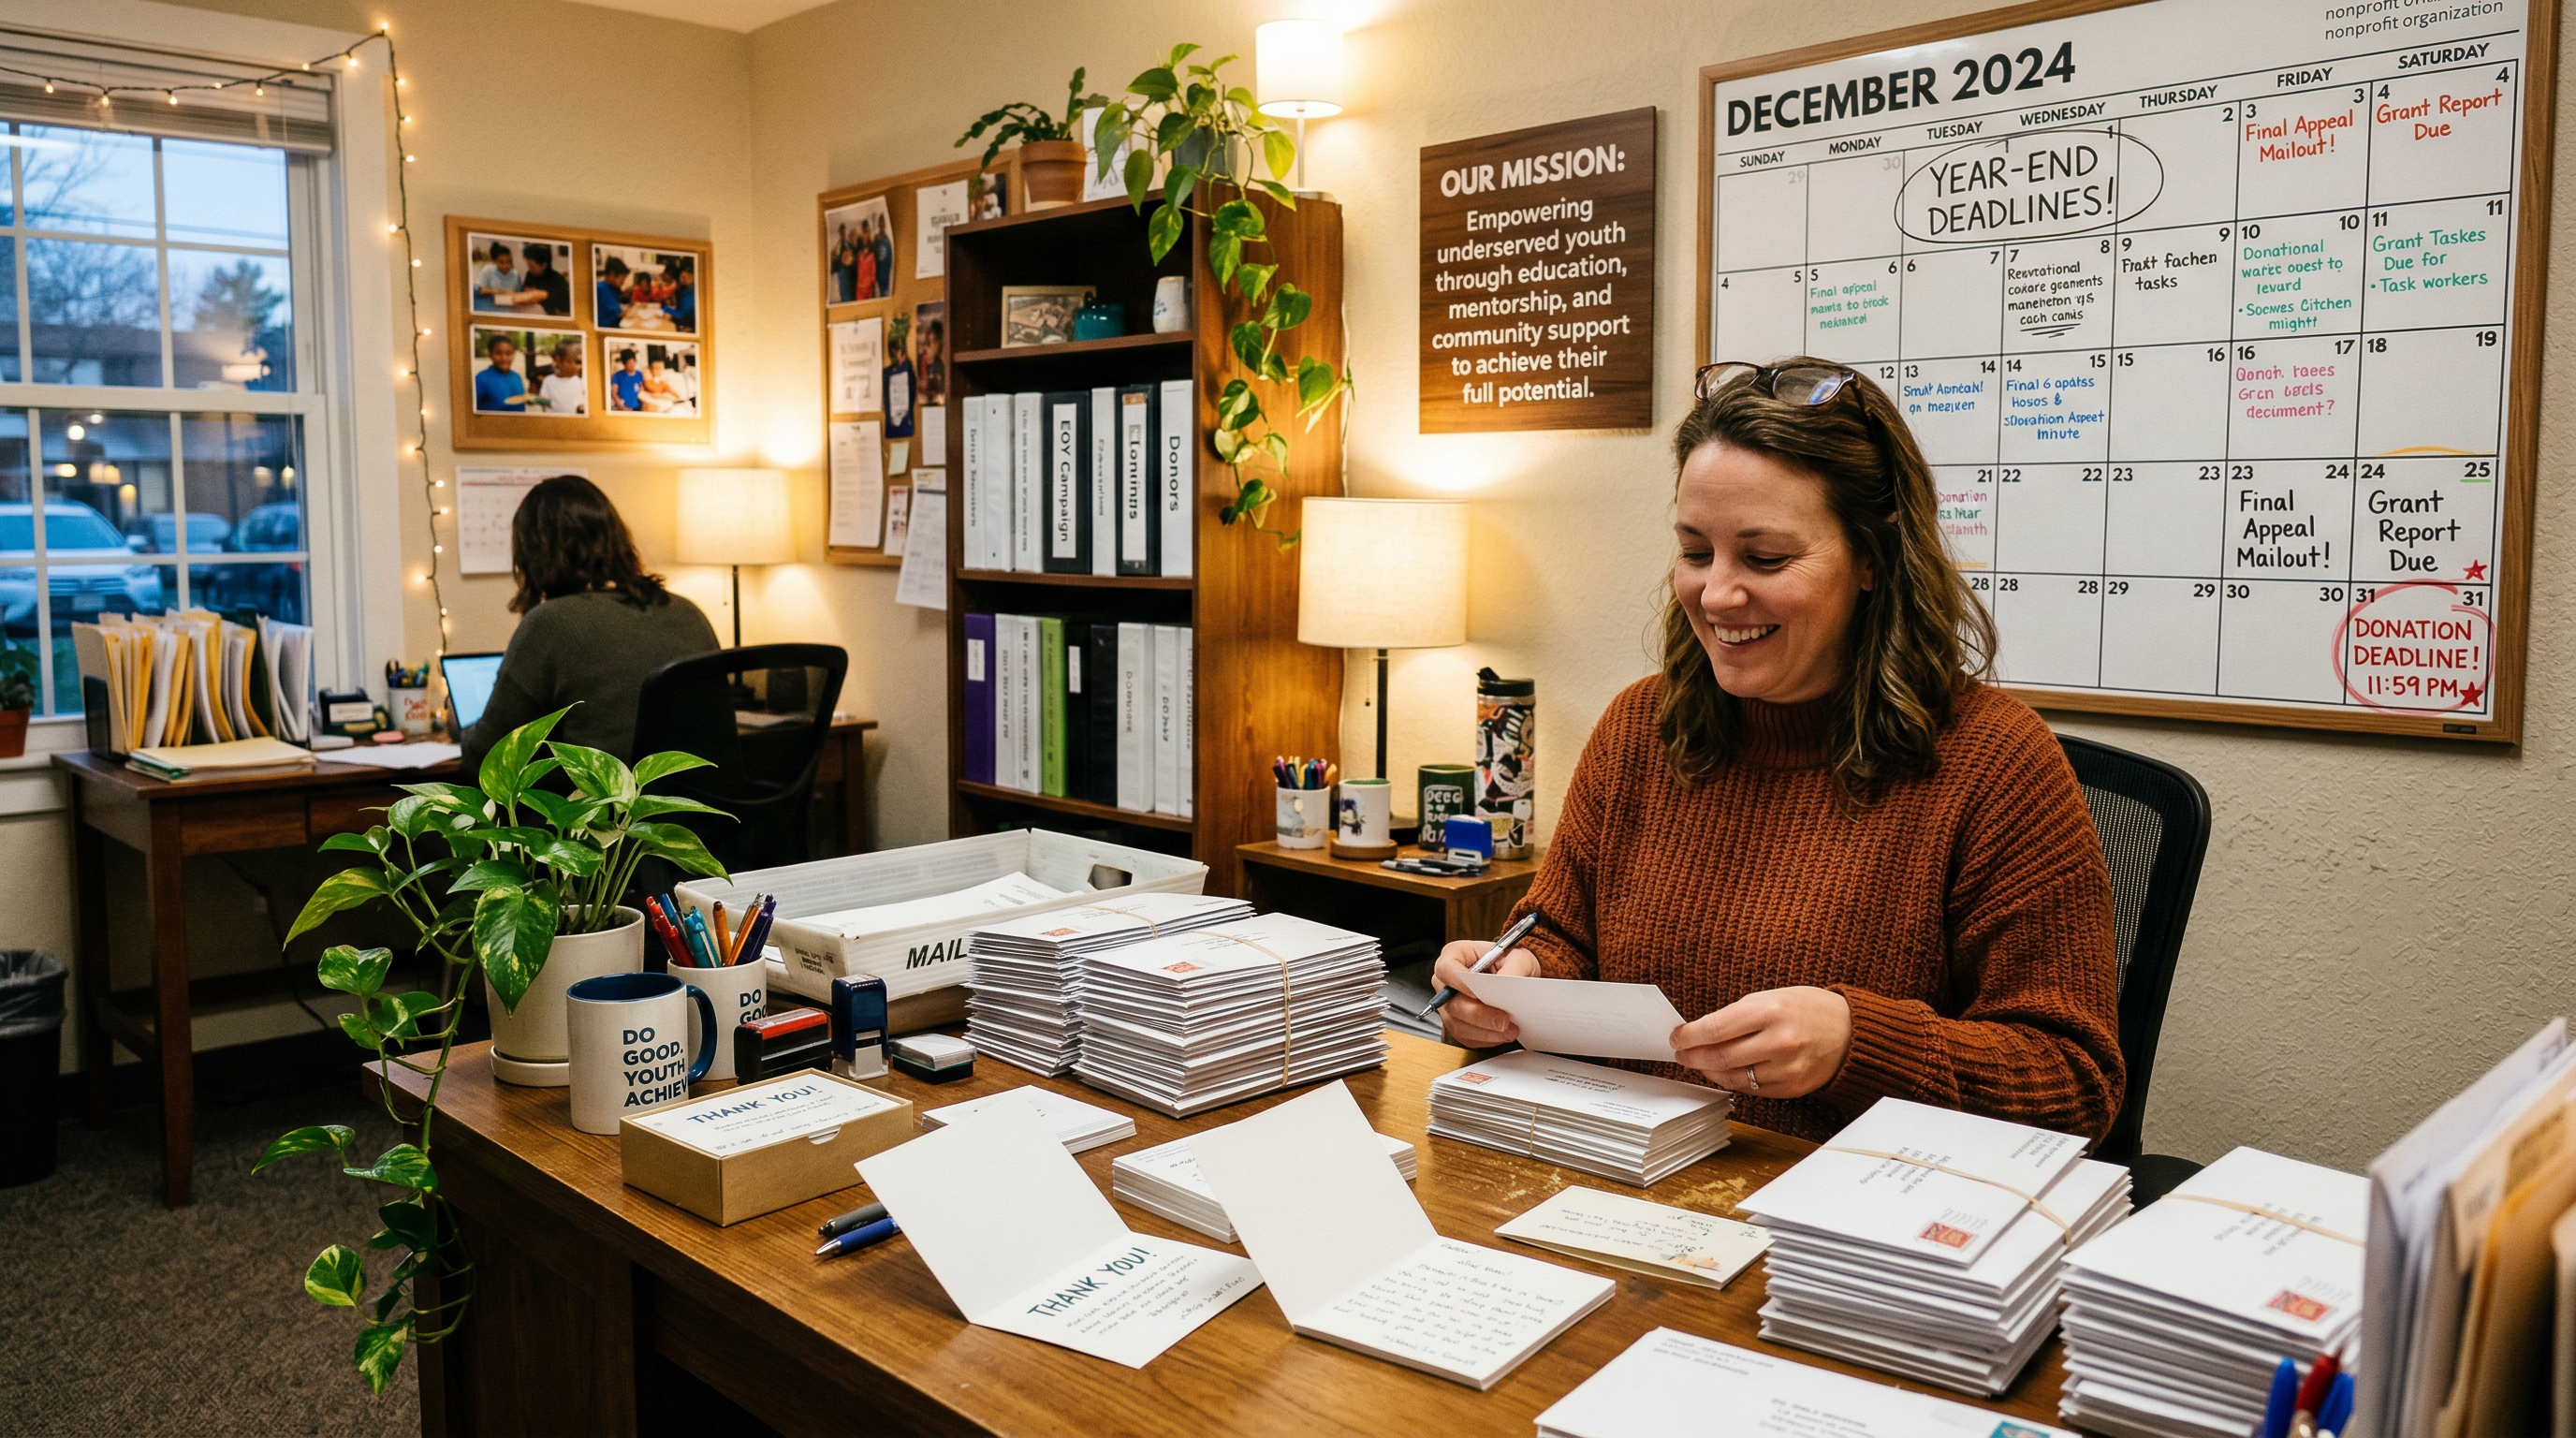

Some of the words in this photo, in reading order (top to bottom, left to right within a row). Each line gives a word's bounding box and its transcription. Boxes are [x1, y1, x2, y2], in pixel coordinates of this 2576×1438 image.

[2325, 0, 2399, 20] nonprofit
[2325, 16, 2398, 39] nonprofit
[2403, 1, 2503, 28] organization
[2397, 42, 2490, 69] SATURDAY
[2276, 67, 2334, 87] FRIDAY
[2496, 66, 2510, 83] 4
[1727, 66, 1939, 137] DECEMBER
[1952, 41, 2075, 101] 2024
[2139, 84, 2218, 109] THURSDAY
[2353, 88, 2364, 104] 3
[2378, 84, 2390, 100] 4
[2019, 100, 2105, 125] WEDNESDAY
[2247, 104, 2257, 119] 3
[2376, 98, 2431, 125] Grant
[2438, 87, 2503, 120] Report
[2222, 108, 2233, 122] 2
[1926, 121, 1983, 140] TUESDAY
[2107, 125, 2114, 139] 1
[2246, 119, 2288, 141] Final
[2293, 109, 2354, 139] Appeal
[2413, 121, 2452, 141] Due
[1829, 137, 1881, 154] MONDAY
[2259, 134, 2335, 163] Mailout!
[1739, 152, 1785, 168] SUNDAY
[1882, 155, 1901, 170] 30
[1441, 164, 1496, 198] OUR
[1500, 143, 1626, 189] MISSION:
[1788, 169, 1806, 184] 29
[1929, 145, 2099, 198] YEAR-END
[1927, 177, 2114, 235] DEADLINES!
[2486, 199, 2503, 215] 11
[1467, 197, 1593, 233] Empowering
[2339, 213, 2360, 230] 10
[2373, 212, 2388, 227] 11
[2219, 227, 2230, 242] 9
[2241, 224, 2261, 240] 10
[1437, 228, 1559, 264] underserved
[1564, 220, 1626, 256] youth
[2100, 240, 2110, 254] 8
[2122, 238, 2132, 252] 9
[2373, 231, 2423, 253] Grant
[2429, 228, 2486, 246] Taskes
[2010, 249, 2019, 263] 7
[2244, 239, 2324, 260] Donational
[1907, 259, 1916, 272] 6
[1990, 251, 1999, 265] 7
[2384, 257, 2414, 271] Due
[2422, 251, 2448, 267] for
[1435, 264, 1513, 293] through
[1517, 254, 1628, 284] education,
[1810, 269, 1819, 282] 5
[1888, 261, 1897, 274] 6
[1720, 277, 1730, 289] 4
[1793, 271, 1802, 283] 5
[2134, 274, 2178, 291] tasks
[2379, 276, 2416, 293] Task
[2422, 271, 2488, 290] workers
[1810, 286, 1837, 299] Final
[1449, 289, 1568, 319] mentorship,
[1573, 283, 1612, 309] and
[1432, 321, 1543, 350] community
[1547, 315, 1630, 344] support
[2237, 345, 2256, 360] 16
[2334, 339, 2356, 355] 17
[2367, 337, 2387, 354] 18
[1452, 357, 1471, 376] to
[1476, 351, 1552, 374] achieve
[1558, 345, 1607, 370] their
[2089, 354, 2106, 368] 15
[2117, 353, 2134, 366] 15
[2207, 347, 2225, 362] 16
[1880, 366, 1895, 379] 12
[1905, 364, 1919, 378] 13
[1981, 360, 1996, 374] 14
[2006, 359, 2022, 373] 14
[1462, 381, 1493, 404] full
[1499, 375, 1595, 408] potential.
[2006, 378, 2039, 391] Final
[1061, 420, 1071, 456] EOY
[1169, 435, 1180, 512] Donors
[1977, 469, 1993, 483] 21
[2002, 469, 2022, 482] 22
[2082, 468, 2102, 482] 22
[2113, 468, 2133, 482] 23
[2199, 466, 2220, 480] 23
[2232, 465, 2254, 480] 23
[2325, 464, 2349, 479] 24
[2361, 463, 2385, 479] 24
[2464, 462, 2491, 477] 25
[1058, 461, 1071, 542] Campaign
[2240, 490, 2294, 512] Final
[2368, 490, 2444, 514] Grant
[2243, 515, 2315, 545] Appeal
[2378, 519, 2461, 549] Report
[2237, 541, 2330, 569] Mailout!
[2389, 550, 2439, 572] Due
[1971, 578, 1989, 591] 28
[1999, 578, 2018, 591] 28
[2078, 580, 2099, 594] 28
[2108, 581, 2129, 594] 29
[2193, 583, 2216, 597] 29
[2226, 584, 2250, 599] 30
[2319, 587, 2344, 602] 30
[2355, 588, 2376, 603] 31
[2463, 591, 2483, 607] 31
[2354, 617, 2472, 640] DONATION
[2354, 645, 2480, 670] DEADLINE!
[2368, 675, 2420, 697] 11:59
[2427, 677, 2458, 697] PM
[906, 937, 968, 970] MAIL
[739, 989, 762, 1007] DO
[622, 1027, 655, 1046] DO
[622, 1041, 683, 1065] GOOD.
[623, 1058, 685, 1087] YOUTH
[686, 1100, 767, 1123] THANK
[766, 1085, 824, 1104] YOU!
[1027, 1276, 1109, 1317] THANK
[1096, 1247, 1157, 1276] YOU!
